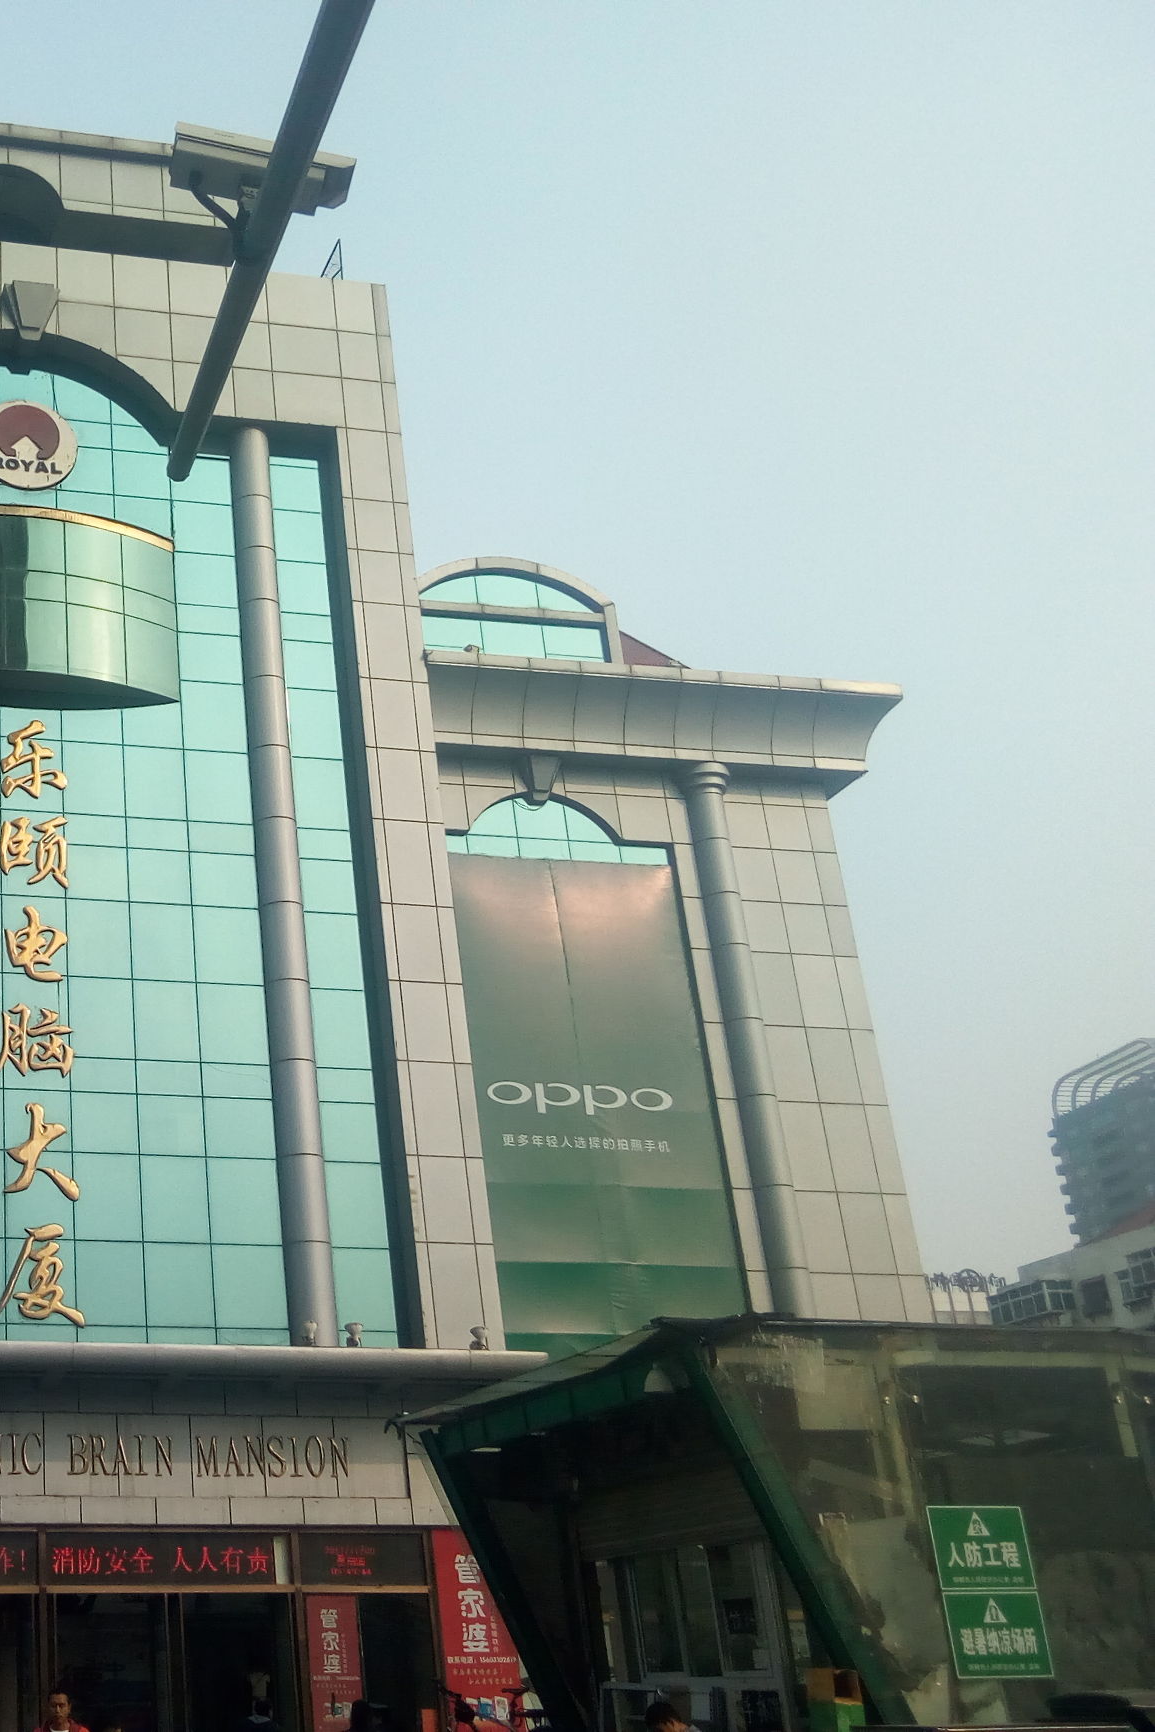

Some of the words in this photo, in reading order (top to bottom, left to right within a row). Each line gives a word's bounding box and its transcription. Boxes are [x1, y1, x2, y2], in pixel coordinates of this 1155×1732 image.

[502, 1133, 671, 1153] 更多年轻人选择的拍照手机
[67, 1433, 173, 1477] BRAIN
[196, 1435, 349, 1478] MANSION
[52, 1546, 154, 1575] 消防安全
[171, 1546, 269, 1575] 人人有责
[948, 1541, 1022, 1568] 人防工程
[454, 1554, 490, 1653] 管家婆
[320, 1608, 342, 1674] 管家婆
[960, 1628, 1038, 1655] 避暑纳凉场所
